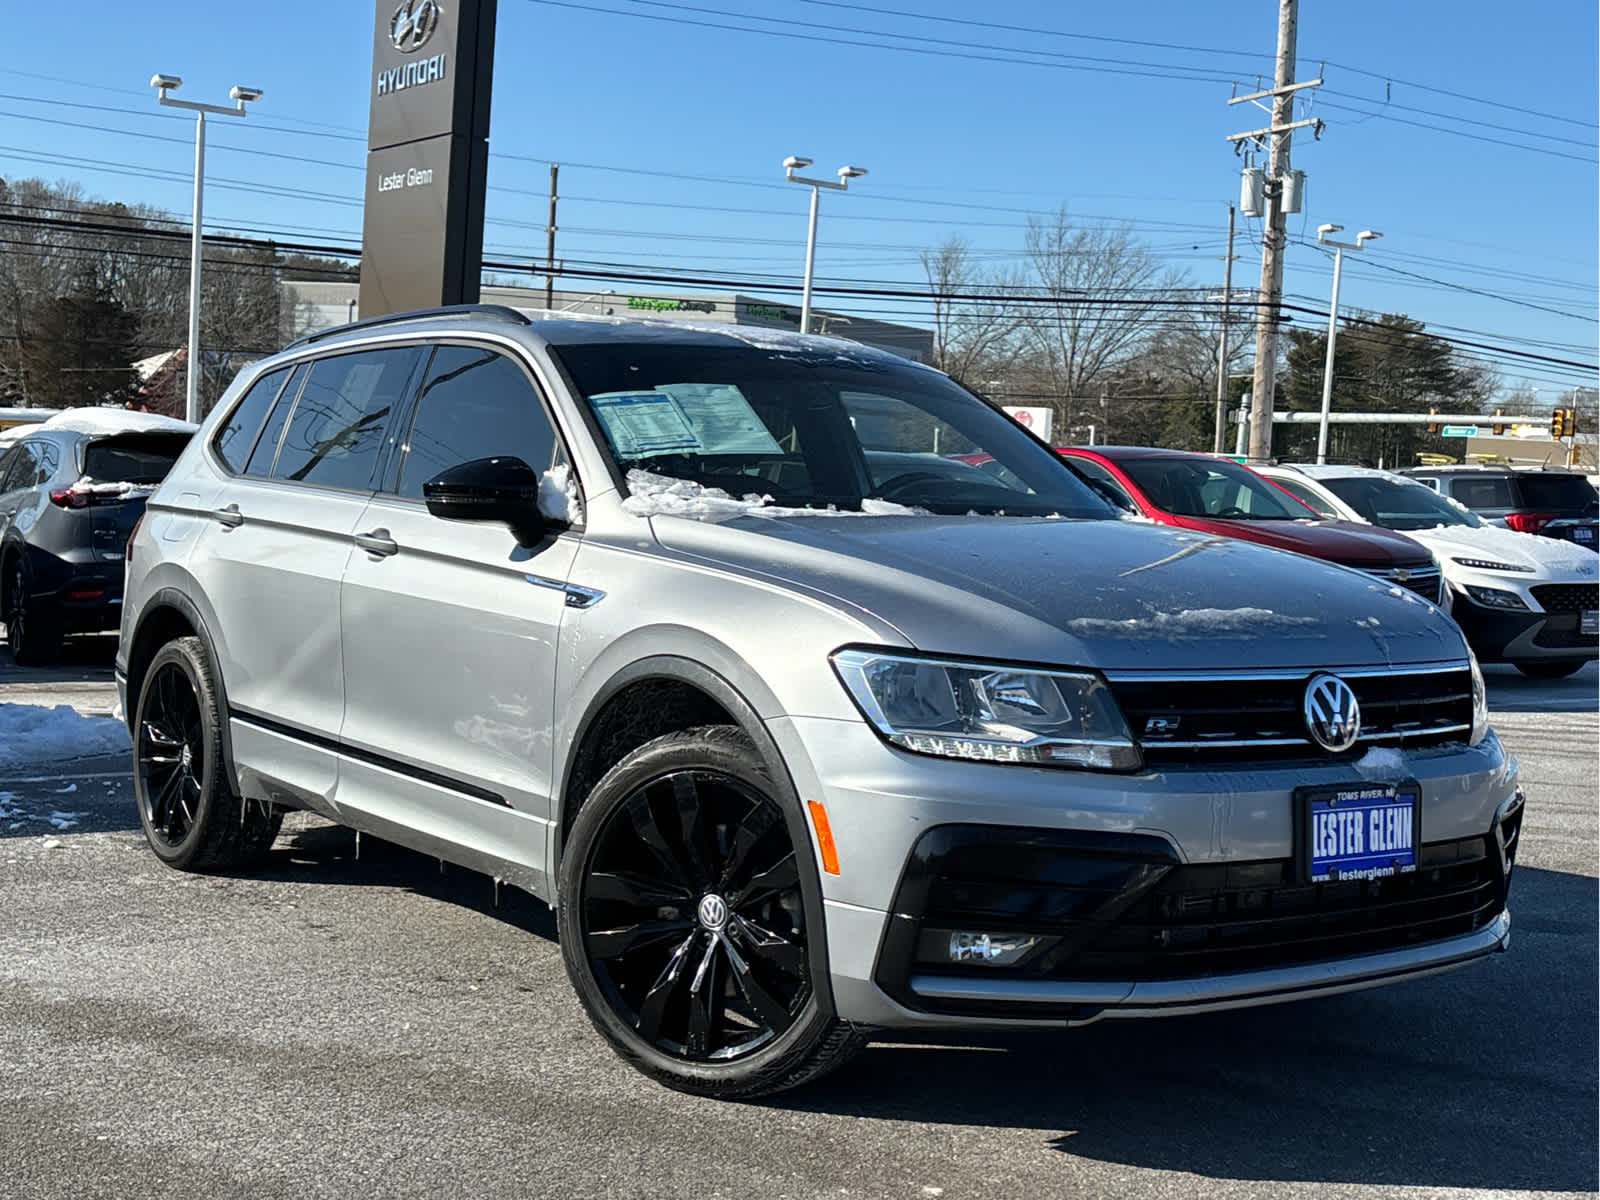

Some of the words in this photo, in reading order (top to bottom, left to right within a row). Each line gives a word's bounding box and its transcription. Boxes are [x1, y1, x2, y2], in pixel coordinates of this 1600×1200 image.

[377, 54, 446, 96] HYUNDAI
[378, 172, 406, 192] Lester
[407, 168, 433, 187] Glenn
[1337, 790, 1360, 801] TOMS
[1312, 811, 1364, 858] LESTER
[1369, 806, 1413, 852] GLENN
[1338, 866, 1395, 881] lesterglenn
